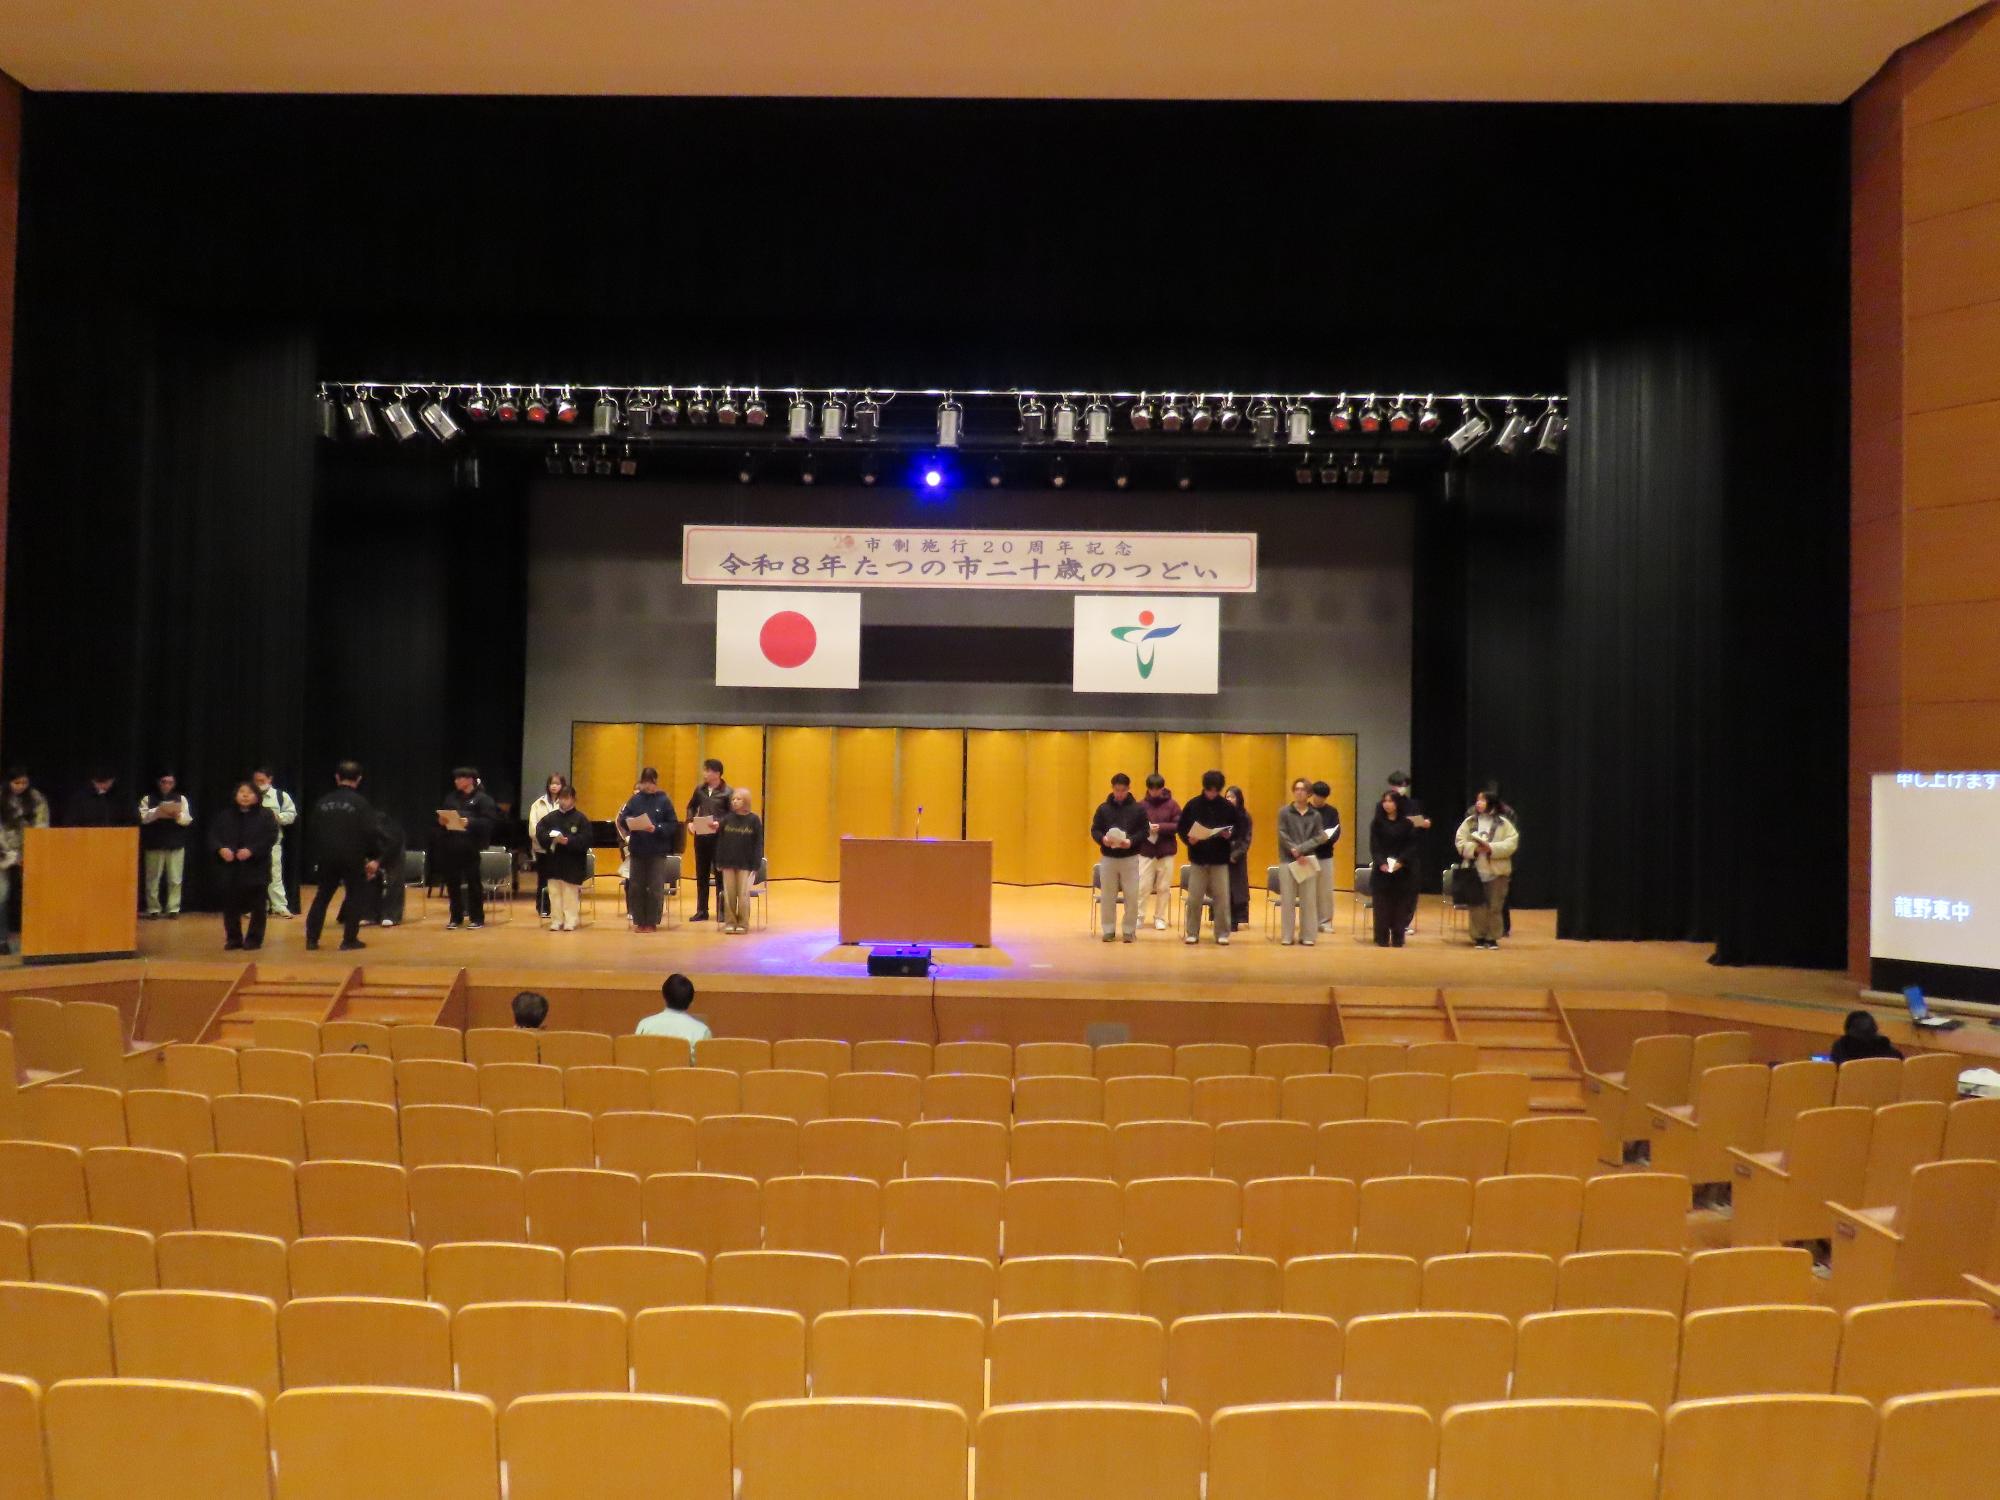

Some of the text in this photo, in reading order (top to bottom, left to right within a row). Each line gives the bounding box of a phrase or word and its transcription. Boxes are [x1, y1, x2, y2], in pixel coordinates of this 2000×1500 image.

[865, 537, 1132, 556] 市制施行20周年記念
[719, 552, 1218, 582] 令和8年たつの市二十歳のつどい
[1894, 896, 1969, 922] 龍野東中
